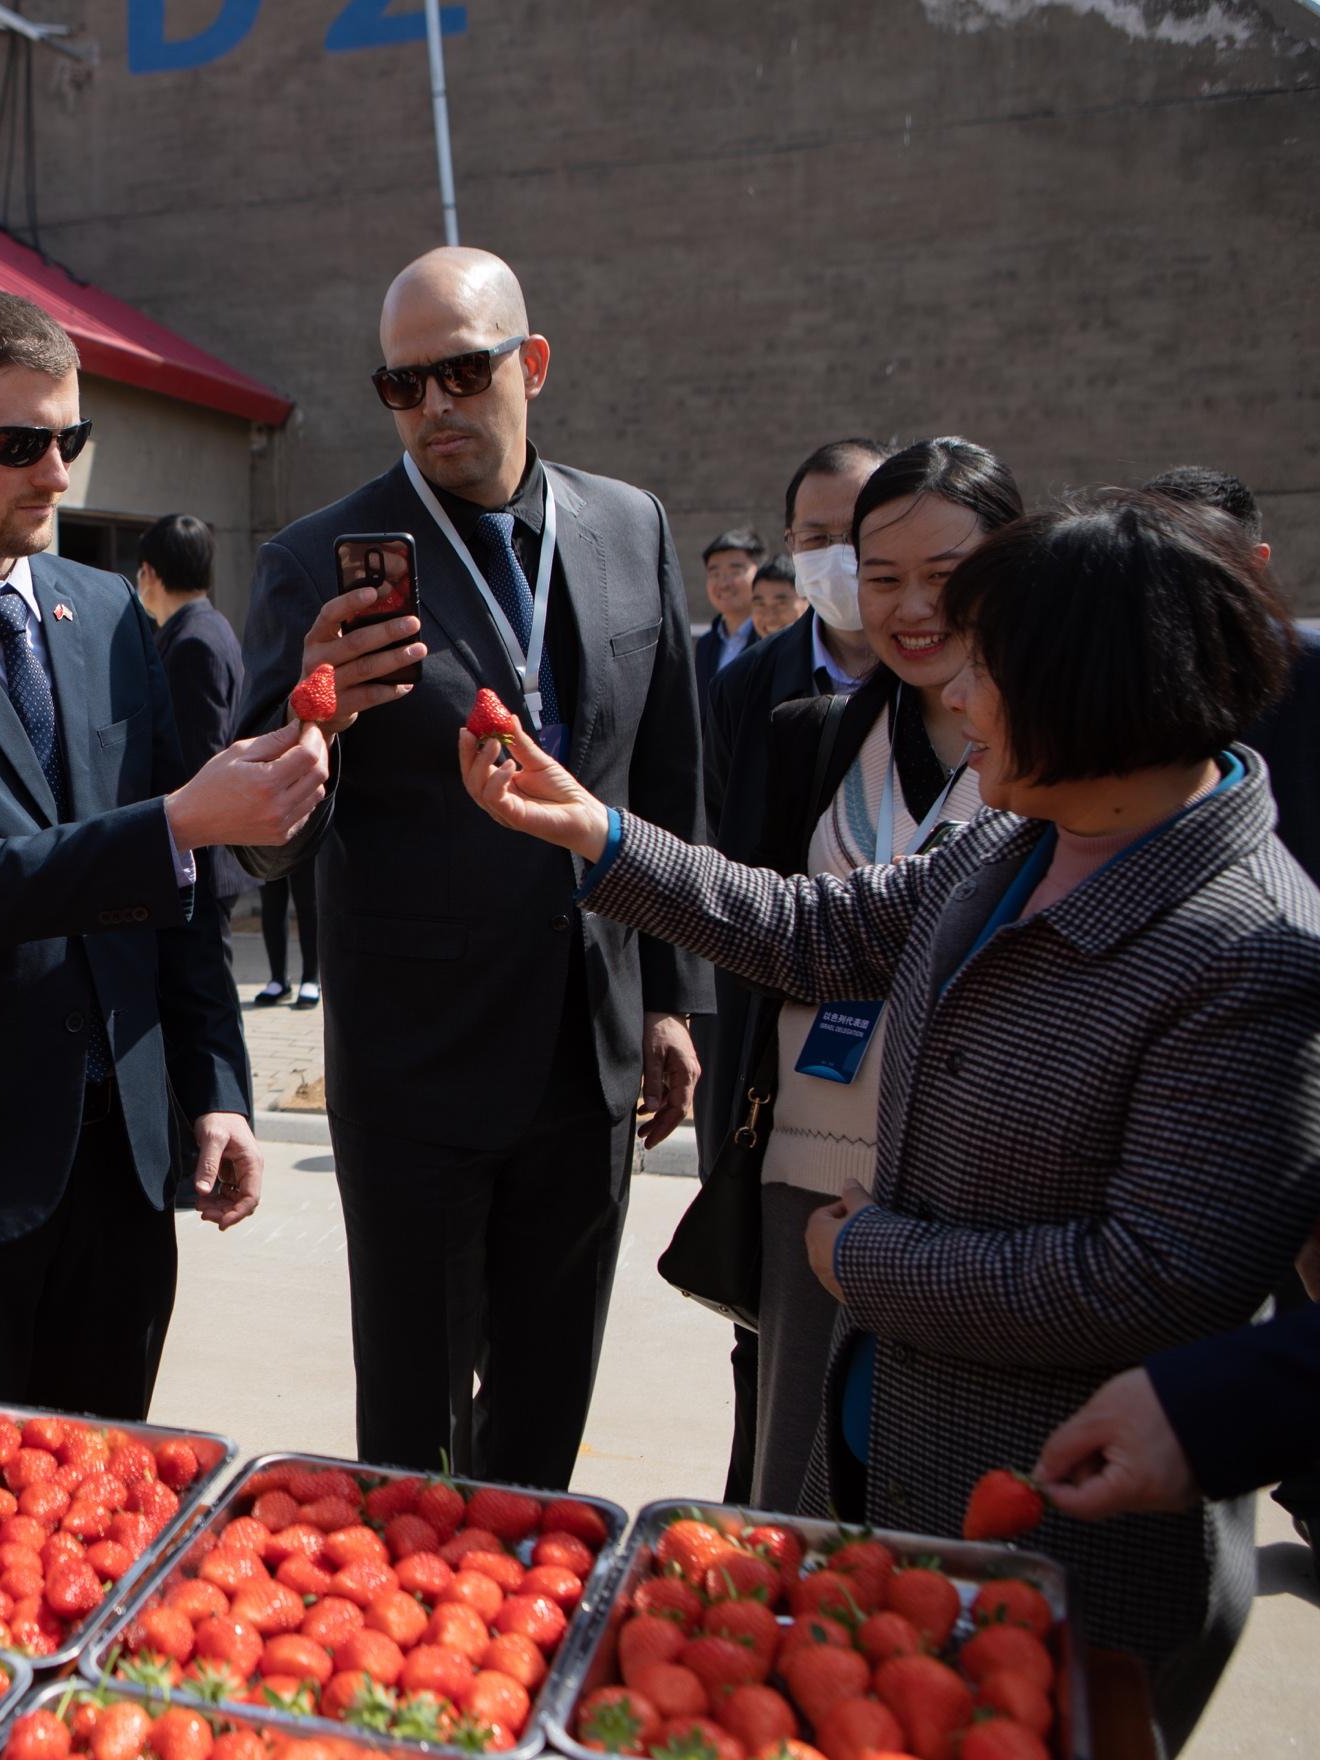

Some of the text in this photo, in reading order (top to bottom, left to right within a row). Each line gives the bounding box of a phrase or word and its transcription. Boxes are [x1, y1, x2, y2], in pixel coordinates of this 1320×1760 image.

[823, 1011, 869, 1029] 以色列代表团
